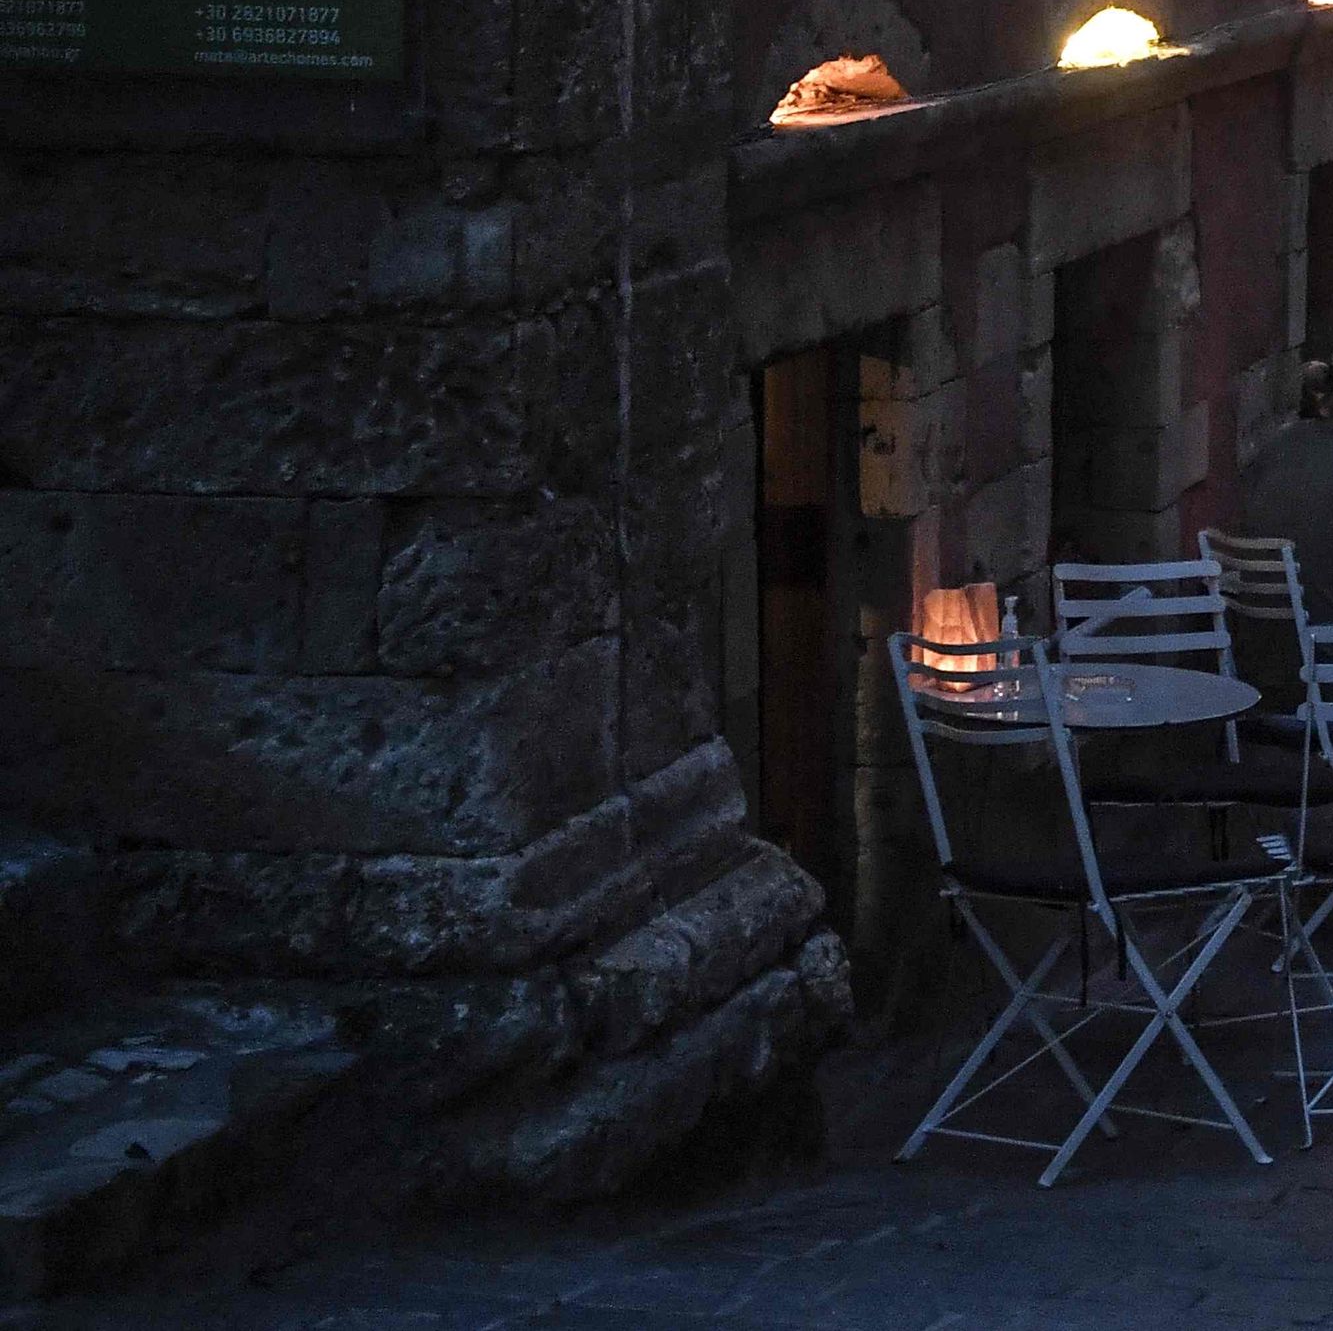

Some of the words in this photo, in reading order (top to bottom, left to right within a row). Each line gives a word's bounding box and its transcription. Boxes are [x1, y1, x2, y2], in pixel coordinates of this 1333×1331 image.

[195, 3, 227, 21] +30
[231, 5, 340, 24] 2821071877
[195, 25, 227, 43] +30
[231, 27, 341, 46] 6936827894
